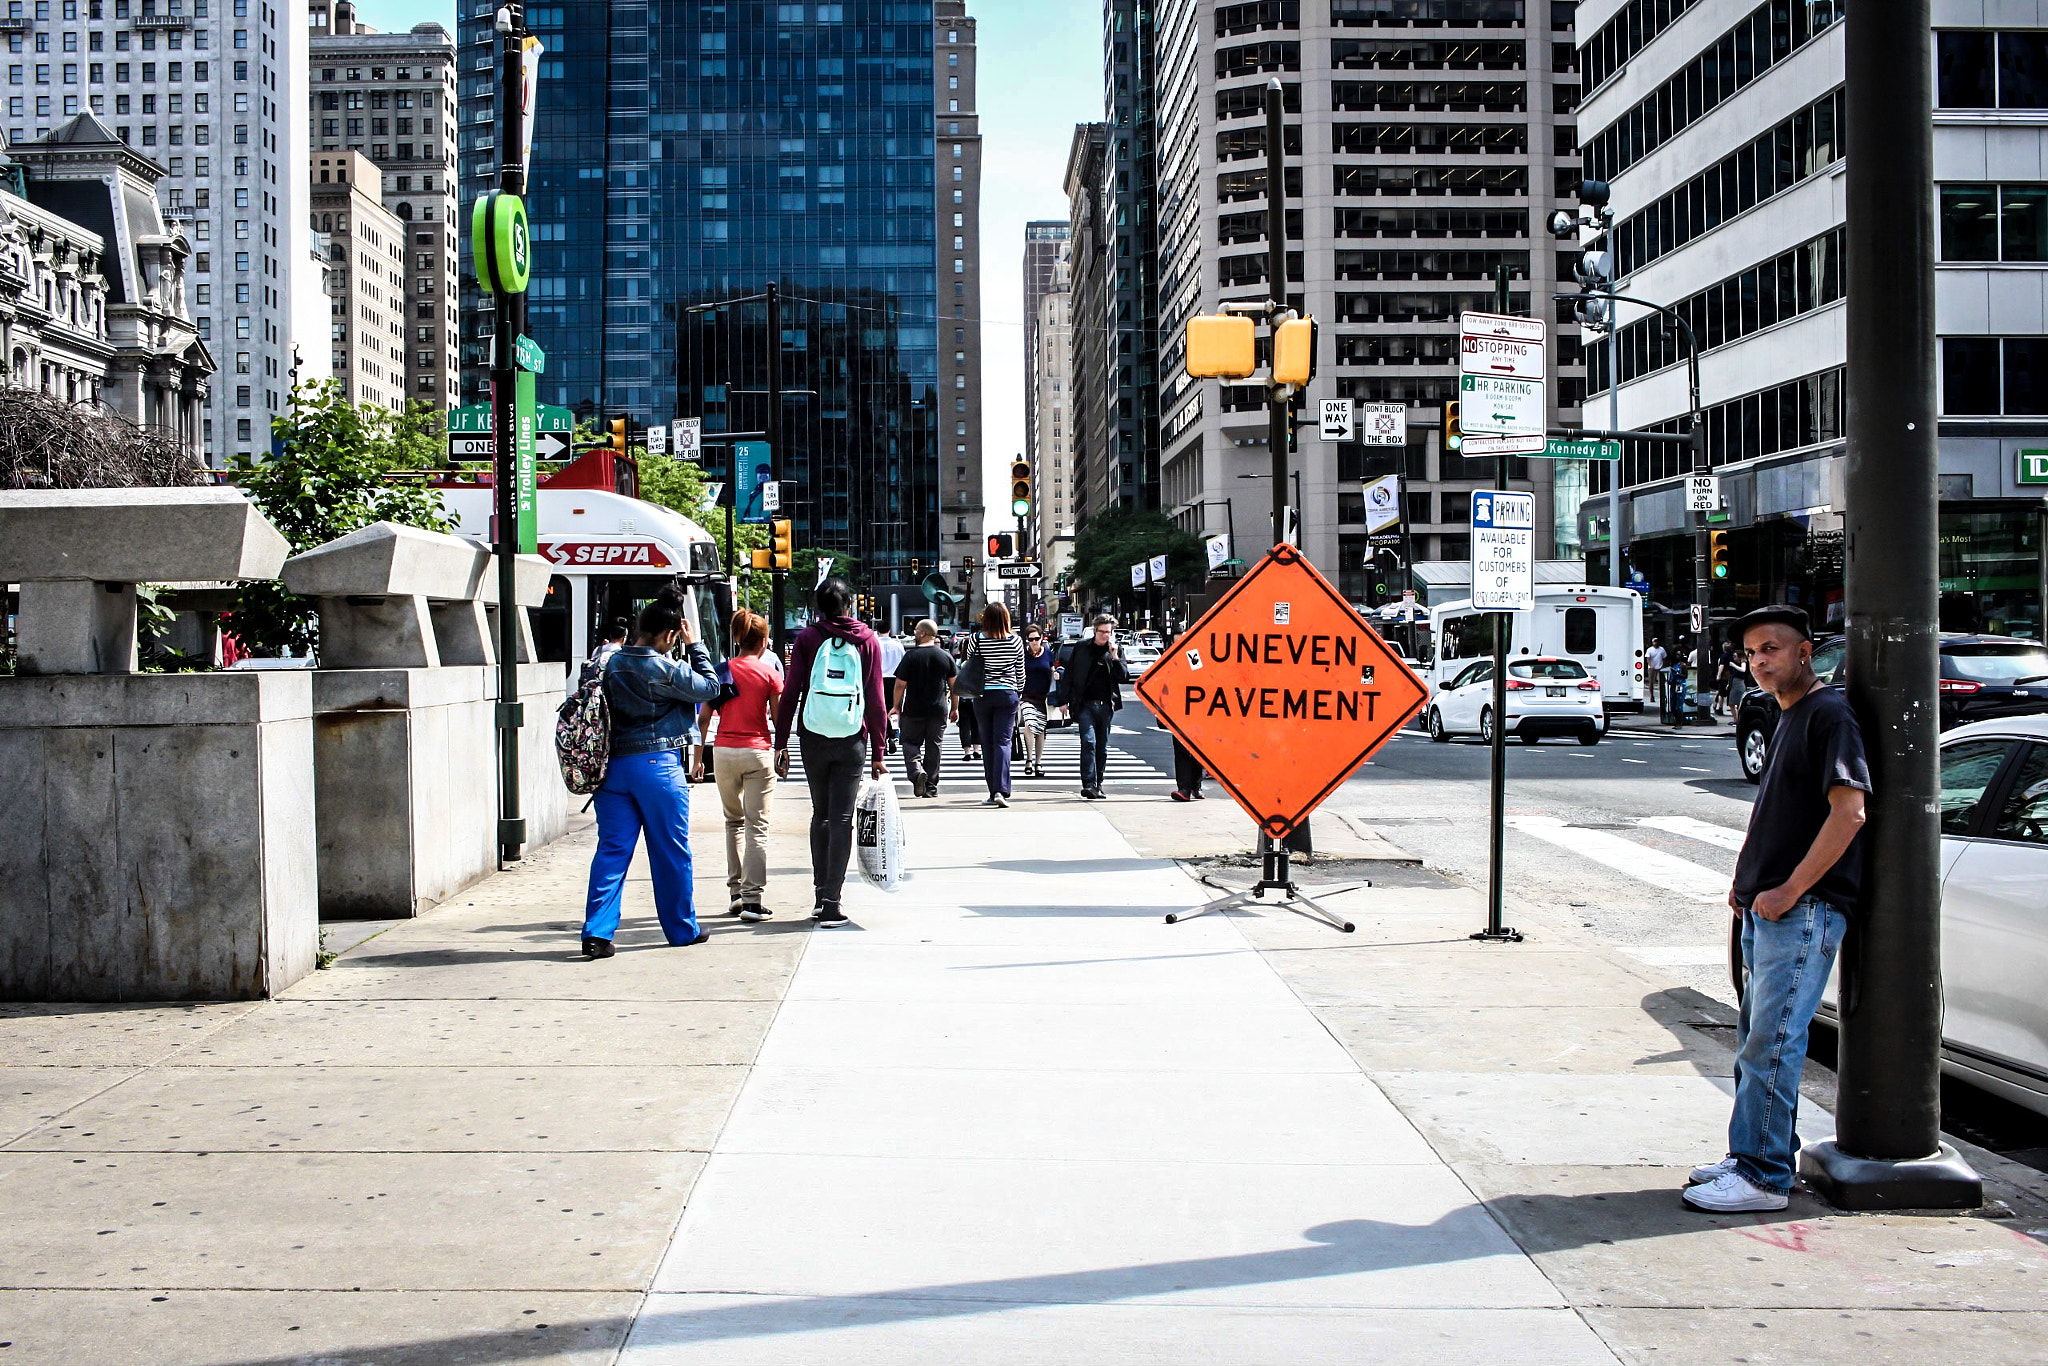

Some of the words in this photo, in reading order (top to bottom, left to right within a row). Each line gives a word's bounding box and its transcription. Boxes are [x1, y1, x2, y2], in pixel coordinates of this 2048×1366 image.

[1463, 339, 1476, 352] NO
[1478, 341, 1527, 356] STOPPING
[1466, 379, 1472, 390] 2
[1477, 380, 1488, 392] HR
[1494, 381, 1531, 395] PARKING
[1326, 403, 1347, 412] ONE
[452, 413, 469, 430] JF
[554, 418, 567, 430] BL
[1325, 414, 1347, 423] WAY
[520, 416, 531, 450] Lines
[1367, 435, 1382, 443] THE
[1386, 436, 1402, 444] BOX
[676, 450, 686, 459] THE
[688, 449, 699, 458] BOX
[739, 447, 748, 456] 25
[1549, 442, 1596, 457] Kennedy
[520, 454, 533, 499] Trolley
[1694, 479, 1711, 487] NO
[1496, 500, 1530, 522] PARKING
[1480, 532, 1526, 544] AVAILABLE
[1952, 535, 1971, 543] Most
[574, 546, 650, 563] SEPTA
[1493, 547, 1512, 558] FOR
[1479, 561, 1526, 572] CUSTOMERS
[1496, 577, 1508, 587] OF
[1940, 582, 1957, 592] Days
[1210, 633, 1356, 666] UNEVEN
[1185, 686, 1381, 721] PAVEMENT
